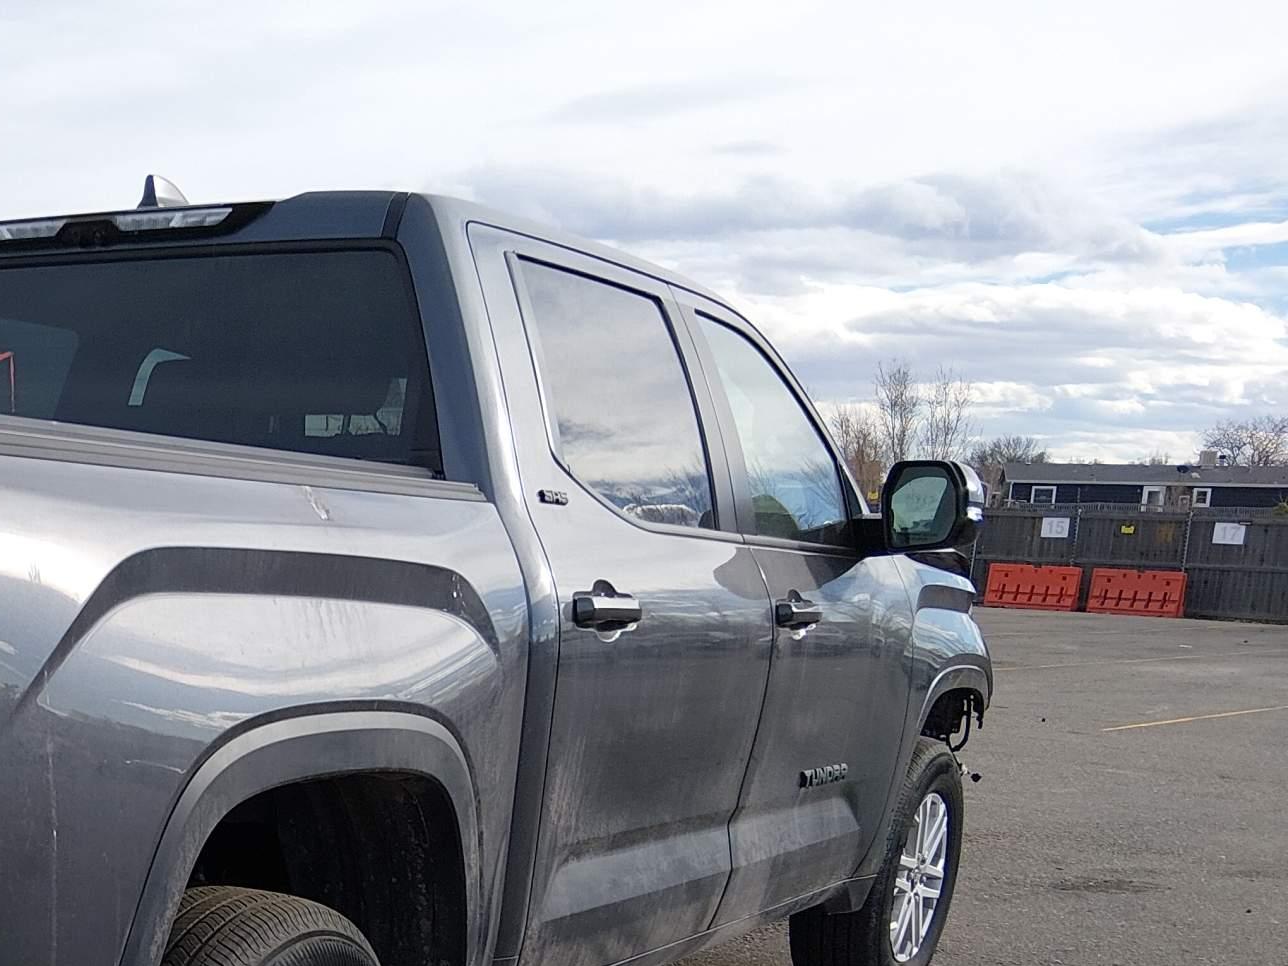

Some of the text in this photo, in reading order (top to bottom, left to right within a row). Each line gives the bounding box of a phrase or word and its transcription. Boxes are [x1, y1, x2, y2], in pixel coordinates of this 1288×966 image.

[1048, 520, 1065, 534] 15
[1223, 525, 1241, 540] 17
[799, 763, 848, 788] TUNDRA
